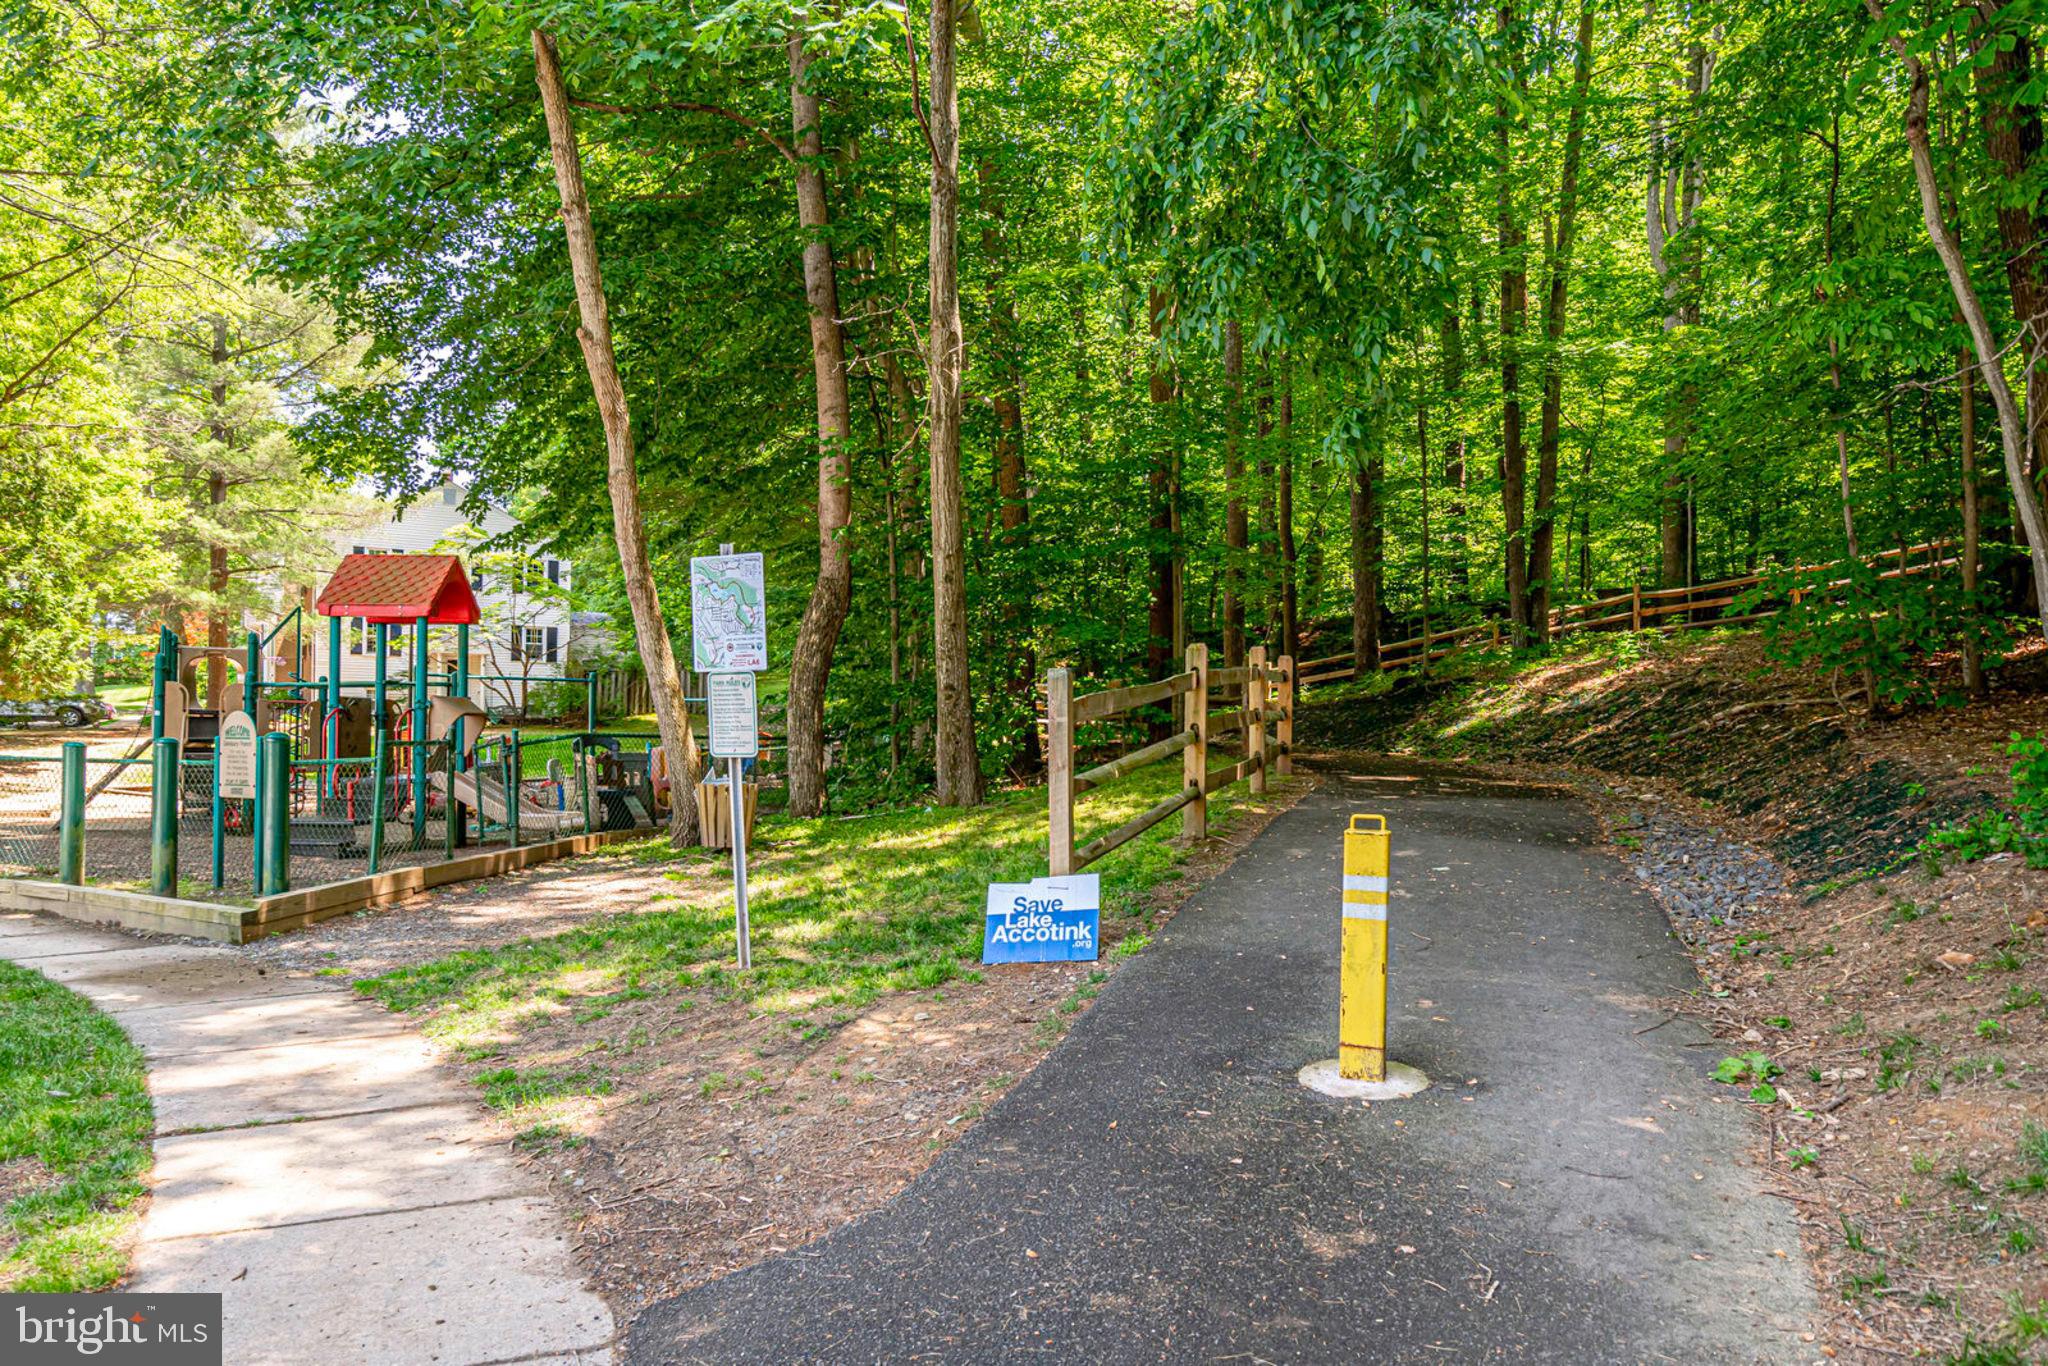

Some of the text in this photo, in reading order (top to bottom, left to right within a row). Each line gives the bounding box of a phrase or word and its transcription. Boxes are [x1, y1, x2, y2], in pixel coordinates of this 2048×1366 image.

[1013, 896, 1064, 913] Save
[1006, 912, 1053, 929] Lake
[991, 921, 1092, 943] Accotink
[1072, 940, 1092, 949] .org
